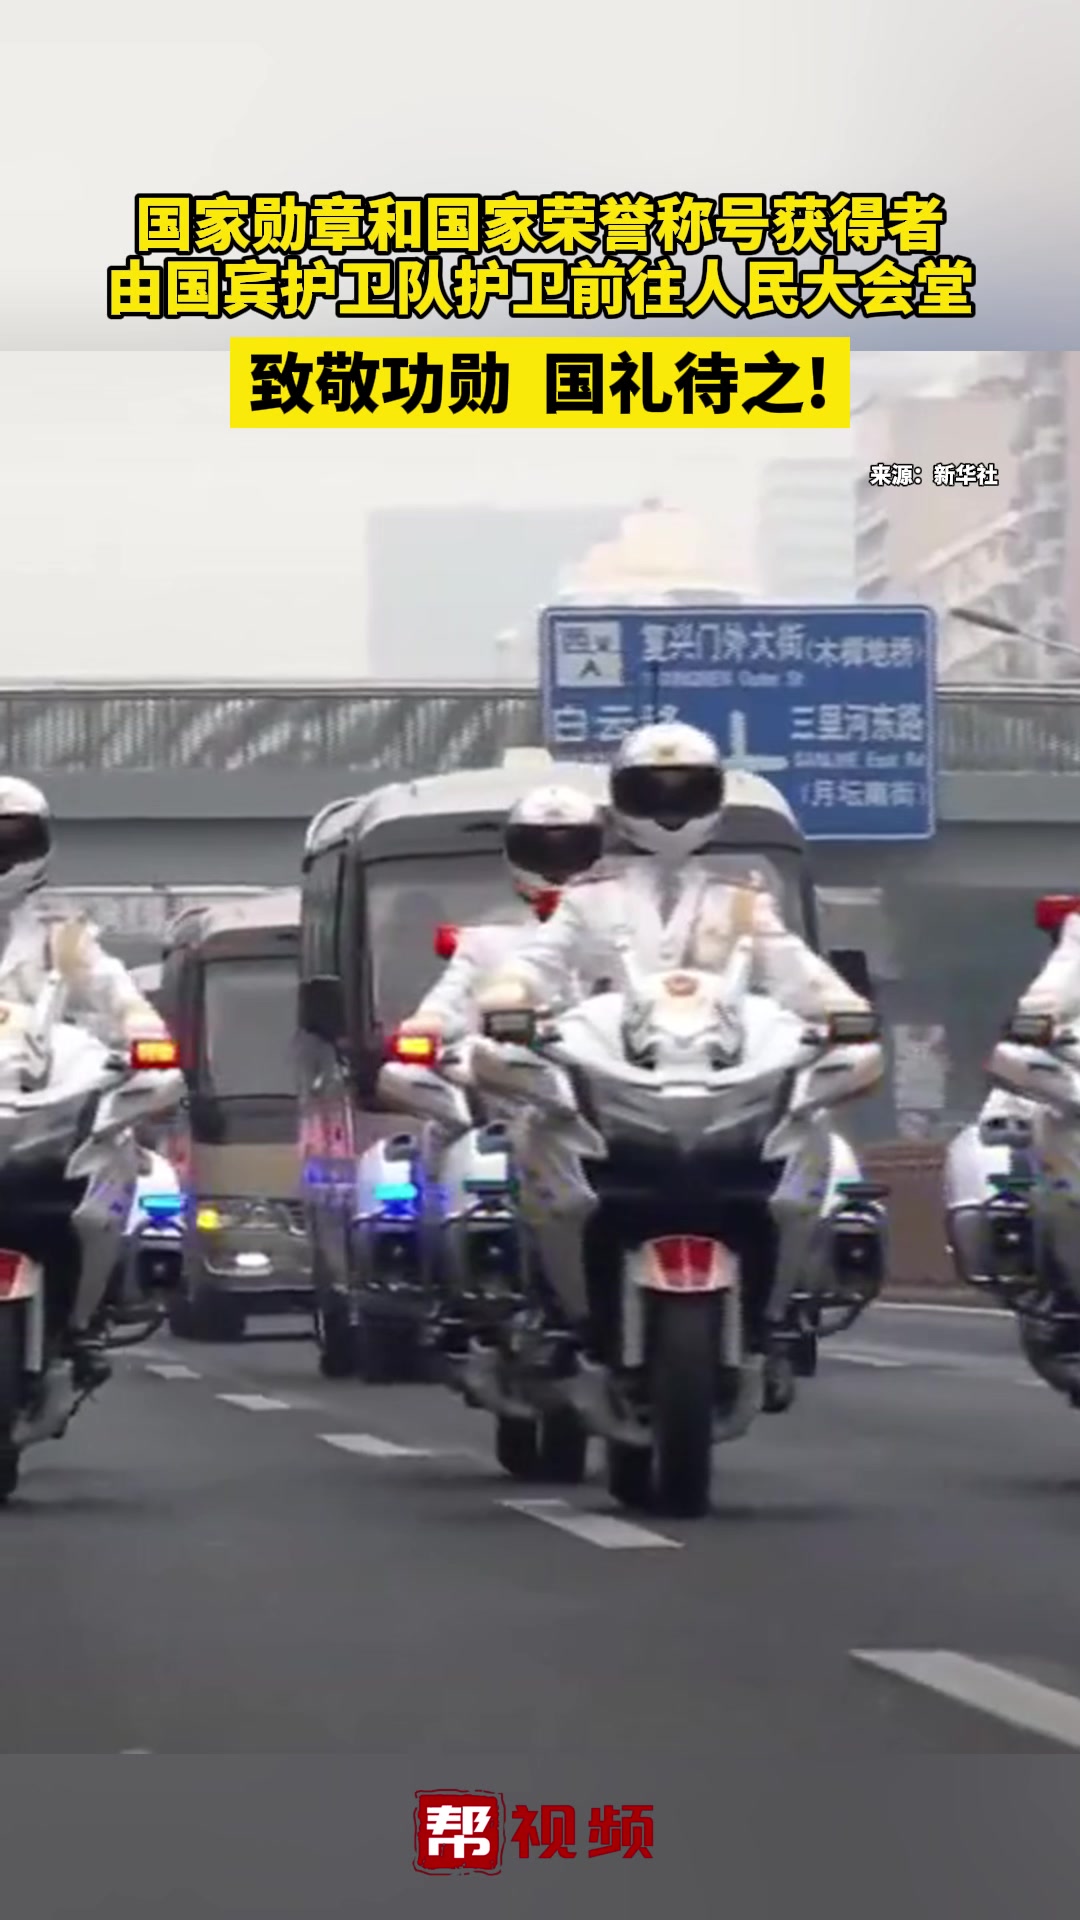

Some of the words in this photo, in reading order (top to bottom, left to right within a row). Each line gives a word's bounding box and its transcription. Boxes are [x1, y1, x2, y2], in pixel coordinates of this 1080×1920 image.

[641, 622, 806, 663] 复兴门外大街
[790, 702, 923, 742] 三里河东路
